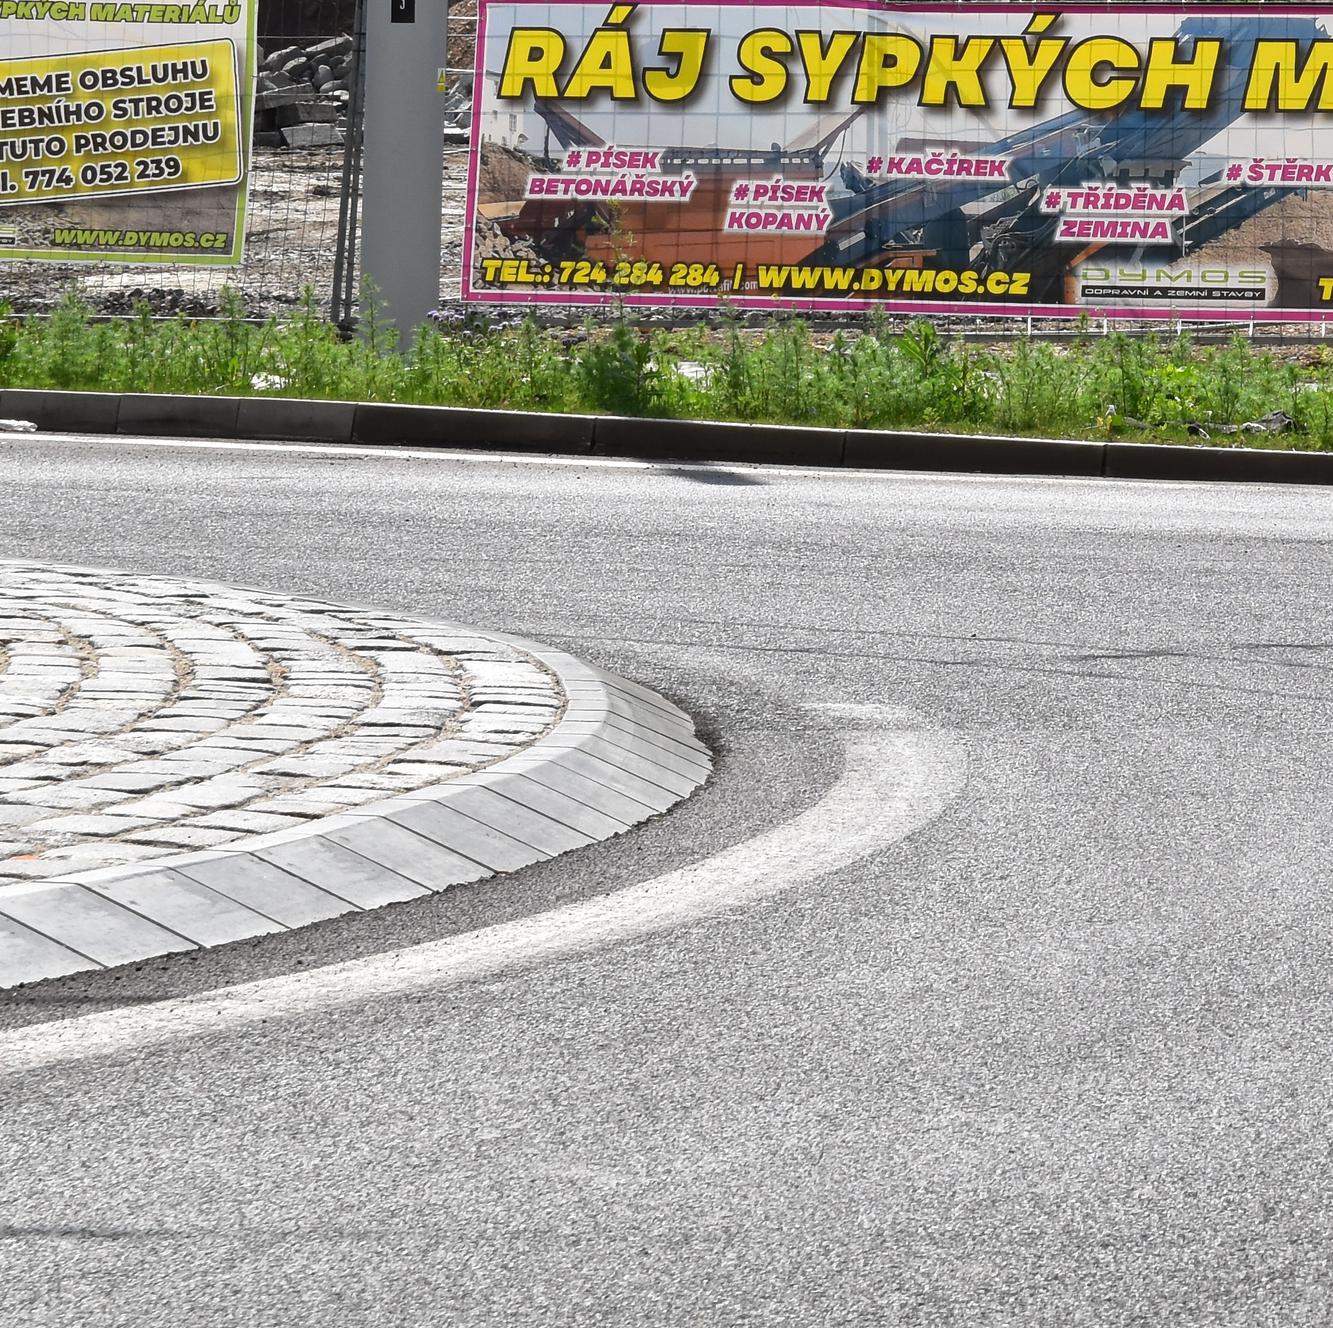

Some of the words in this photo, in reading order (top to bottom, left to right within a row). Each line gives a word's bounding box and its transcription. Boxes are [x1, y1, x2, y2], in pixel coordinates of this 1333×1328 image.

[497, 3, 711, 103] RÁJ
[729, 12, 1224, 112] SYPKÝCH
[79, 59, 208, 90] OBSLUHU
[112, 90, 214, 119] STROJE
[74, 121, 220, 154] PRODEJNU
[25, 167, 73, 190] 774
[81, 162, 129, 185] 052
[135, 156, 181, 180] 239
[529, 172, 695, 197] BETONÁŘSKÝ
[728, 205, 830, 230] KOPANÝ
[1059, 219, 1169, 239] ZEMINA
[54, 228, 228, 248] WWW.DYMOS.CZ
[481, 259, 552, 284] TEL.:
[558, 260, 607, 285] 724
[614, 262, 663, 286] 284
[669, 263, 720, 287] 284
[757, 265, 1032, 295] WWW.DYMOS.CZ
[1082, 268, 1267, 284] DYMOS
[1085, 286, 1149, 296] DOPRAVNÍ
[1167, 288, 1208, 297] ZEMNÍ
[1212, 290, 1262, 298] STAVBY
